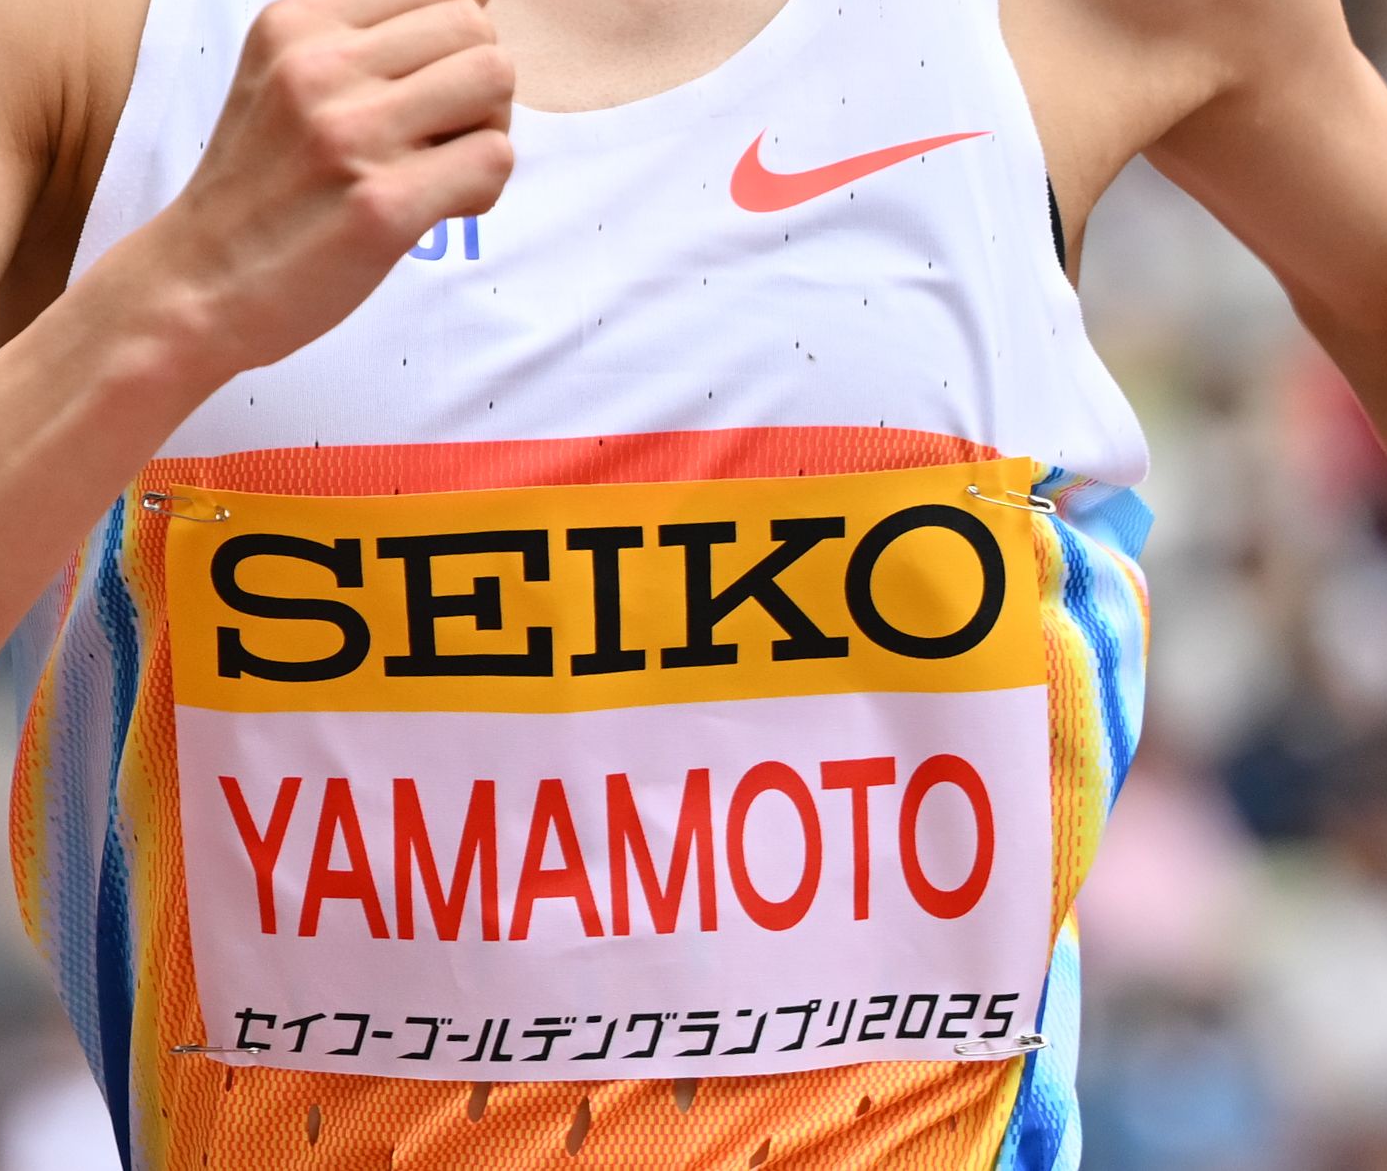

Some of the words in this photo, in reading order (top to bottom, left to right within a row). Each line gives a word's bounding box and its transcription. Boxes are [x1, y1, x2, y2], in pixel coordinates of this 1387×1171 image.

[210, 503, 1007, 684] SEIKO
[216, 752, 997, 944] YAMAMOTO
[233, 991, 1021, 1063] セイコーゴールデングランプリ2025
